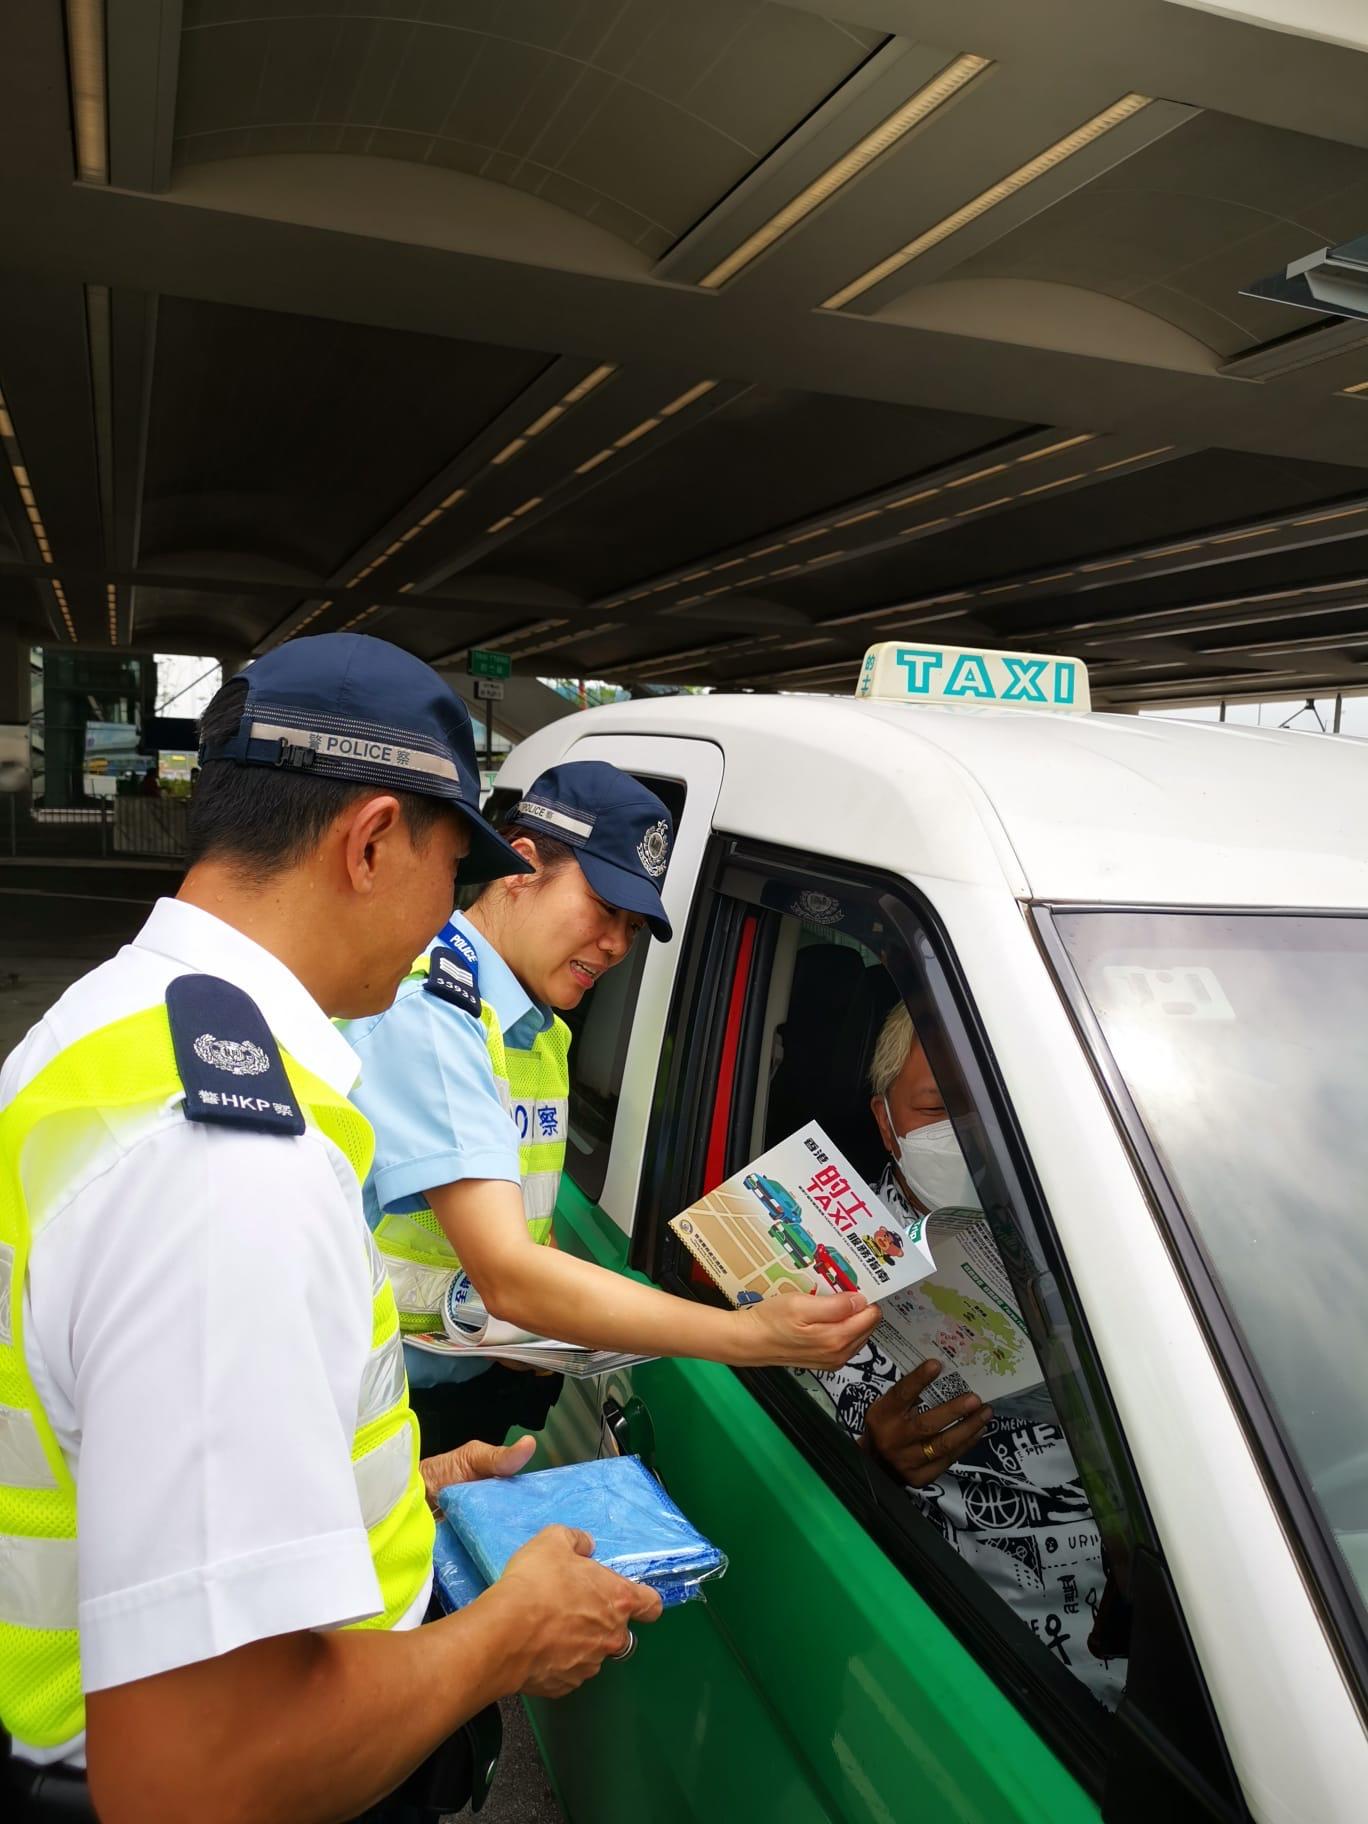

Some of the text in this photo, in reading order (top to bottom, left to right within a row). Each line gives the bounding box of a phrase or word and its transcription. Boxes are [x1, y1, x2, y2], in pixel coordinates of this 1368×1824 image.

[896, 649, 1075, 704] TAXI
[327, 738, 392, 761] POLICE
[396, 750, 411, 766] 察
[450, 934, 478, 962] POLICE
[221, 1092, 270, 1112] HKP
[537, 1104, 559, 1136] 察
[804, 1137, 829, 1165] 香港
[806, 1177, 856, 1232] TAXI
[815, 1164, 873, 1219] 的士
